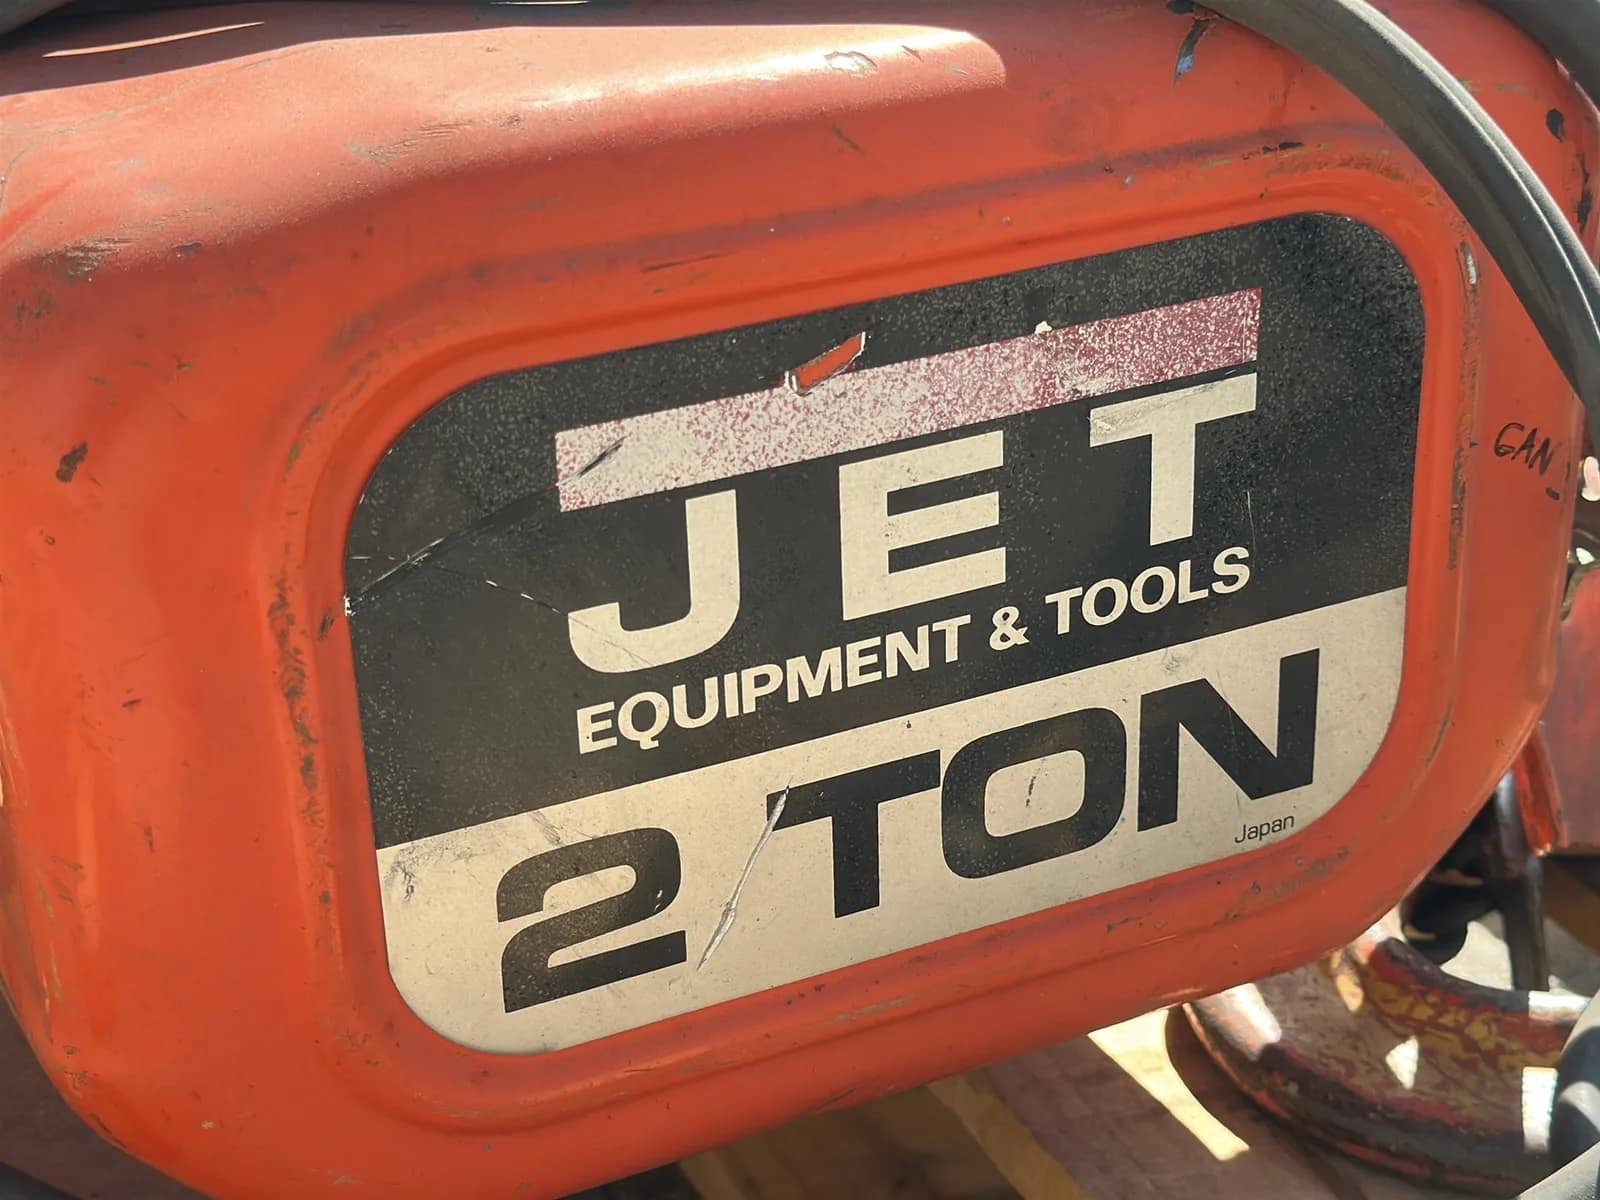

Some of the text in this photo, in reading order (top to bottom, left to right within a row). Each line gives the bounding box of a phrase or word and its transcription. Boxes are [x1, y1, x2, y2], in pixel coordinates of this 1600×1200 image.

[567, 372, 1258, 675] JET
[576, 545, 1252, 755] EQUIPMENT & TOOLS
[496, 643, 1321, 1014] 2 TON
[1234, 815, 1295, 844] Japan
